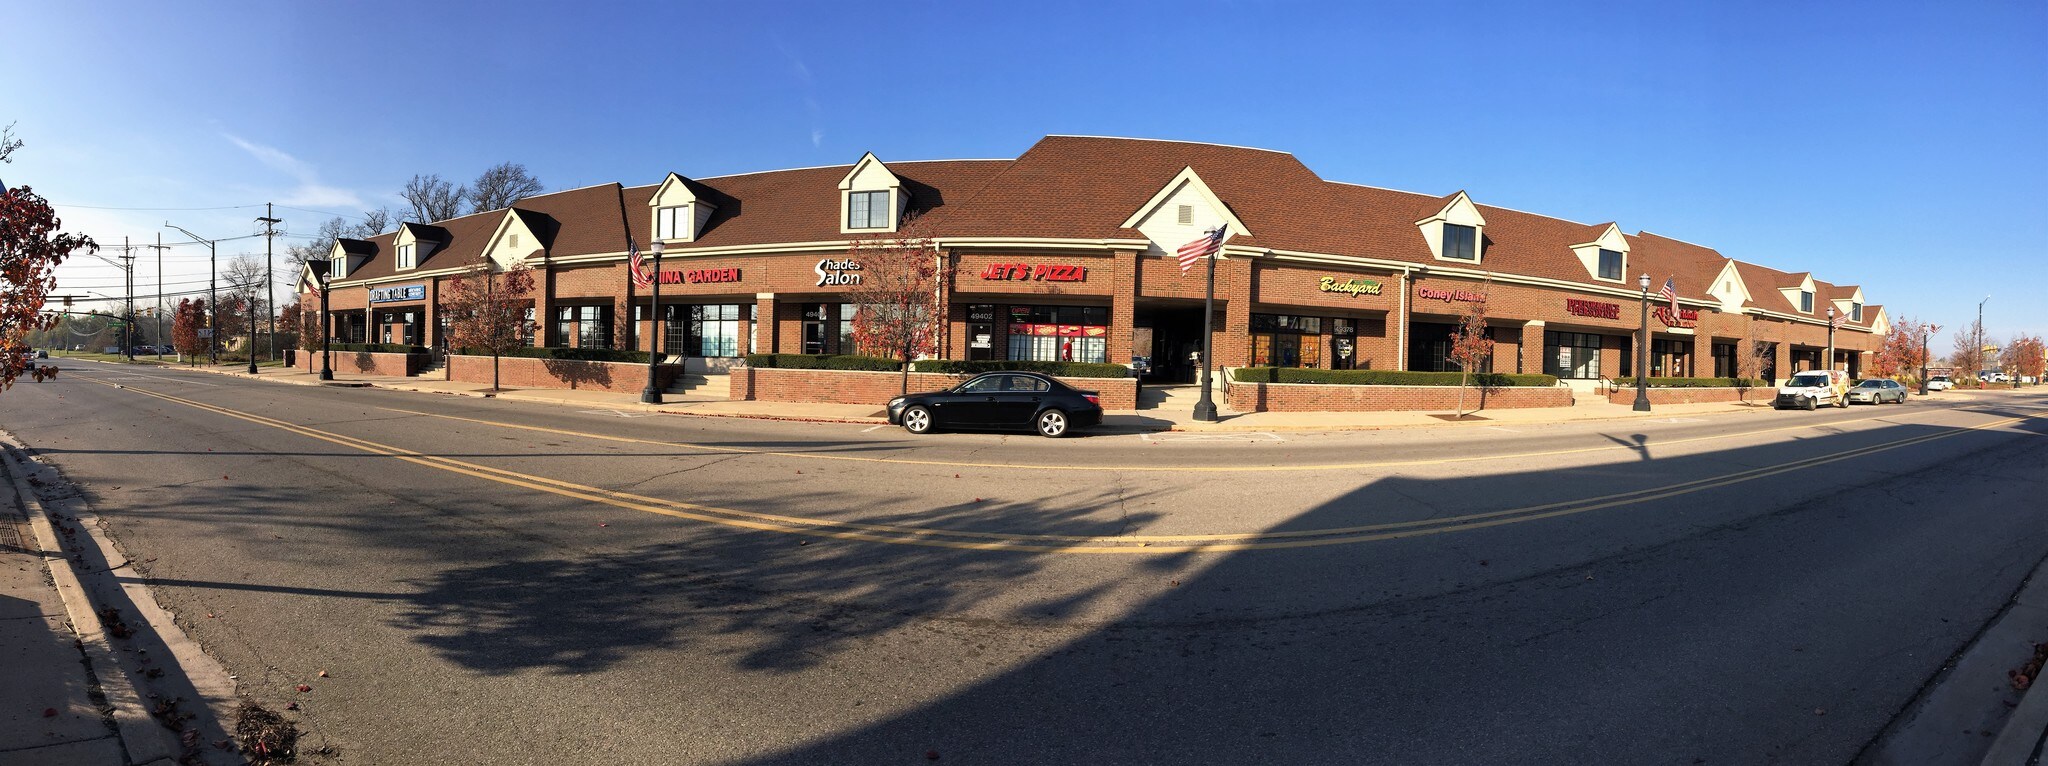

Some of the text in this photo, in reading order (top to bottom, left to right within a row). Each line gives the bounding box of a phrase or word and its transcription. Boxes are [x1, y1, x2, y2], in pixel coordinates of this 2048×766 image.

[815, 259, 861, 275] Shades
[980, 263, 1085, 281] JET'S PIZZA
[687, 268, 739, 284] GARDEN
[815, 268, 861, 286] Salon
[1319, 276, 1381, 296] Backyard
[1419, 287, 1452, 301] Coney
[1572, 306, 1620, 320] PERSONNEL
